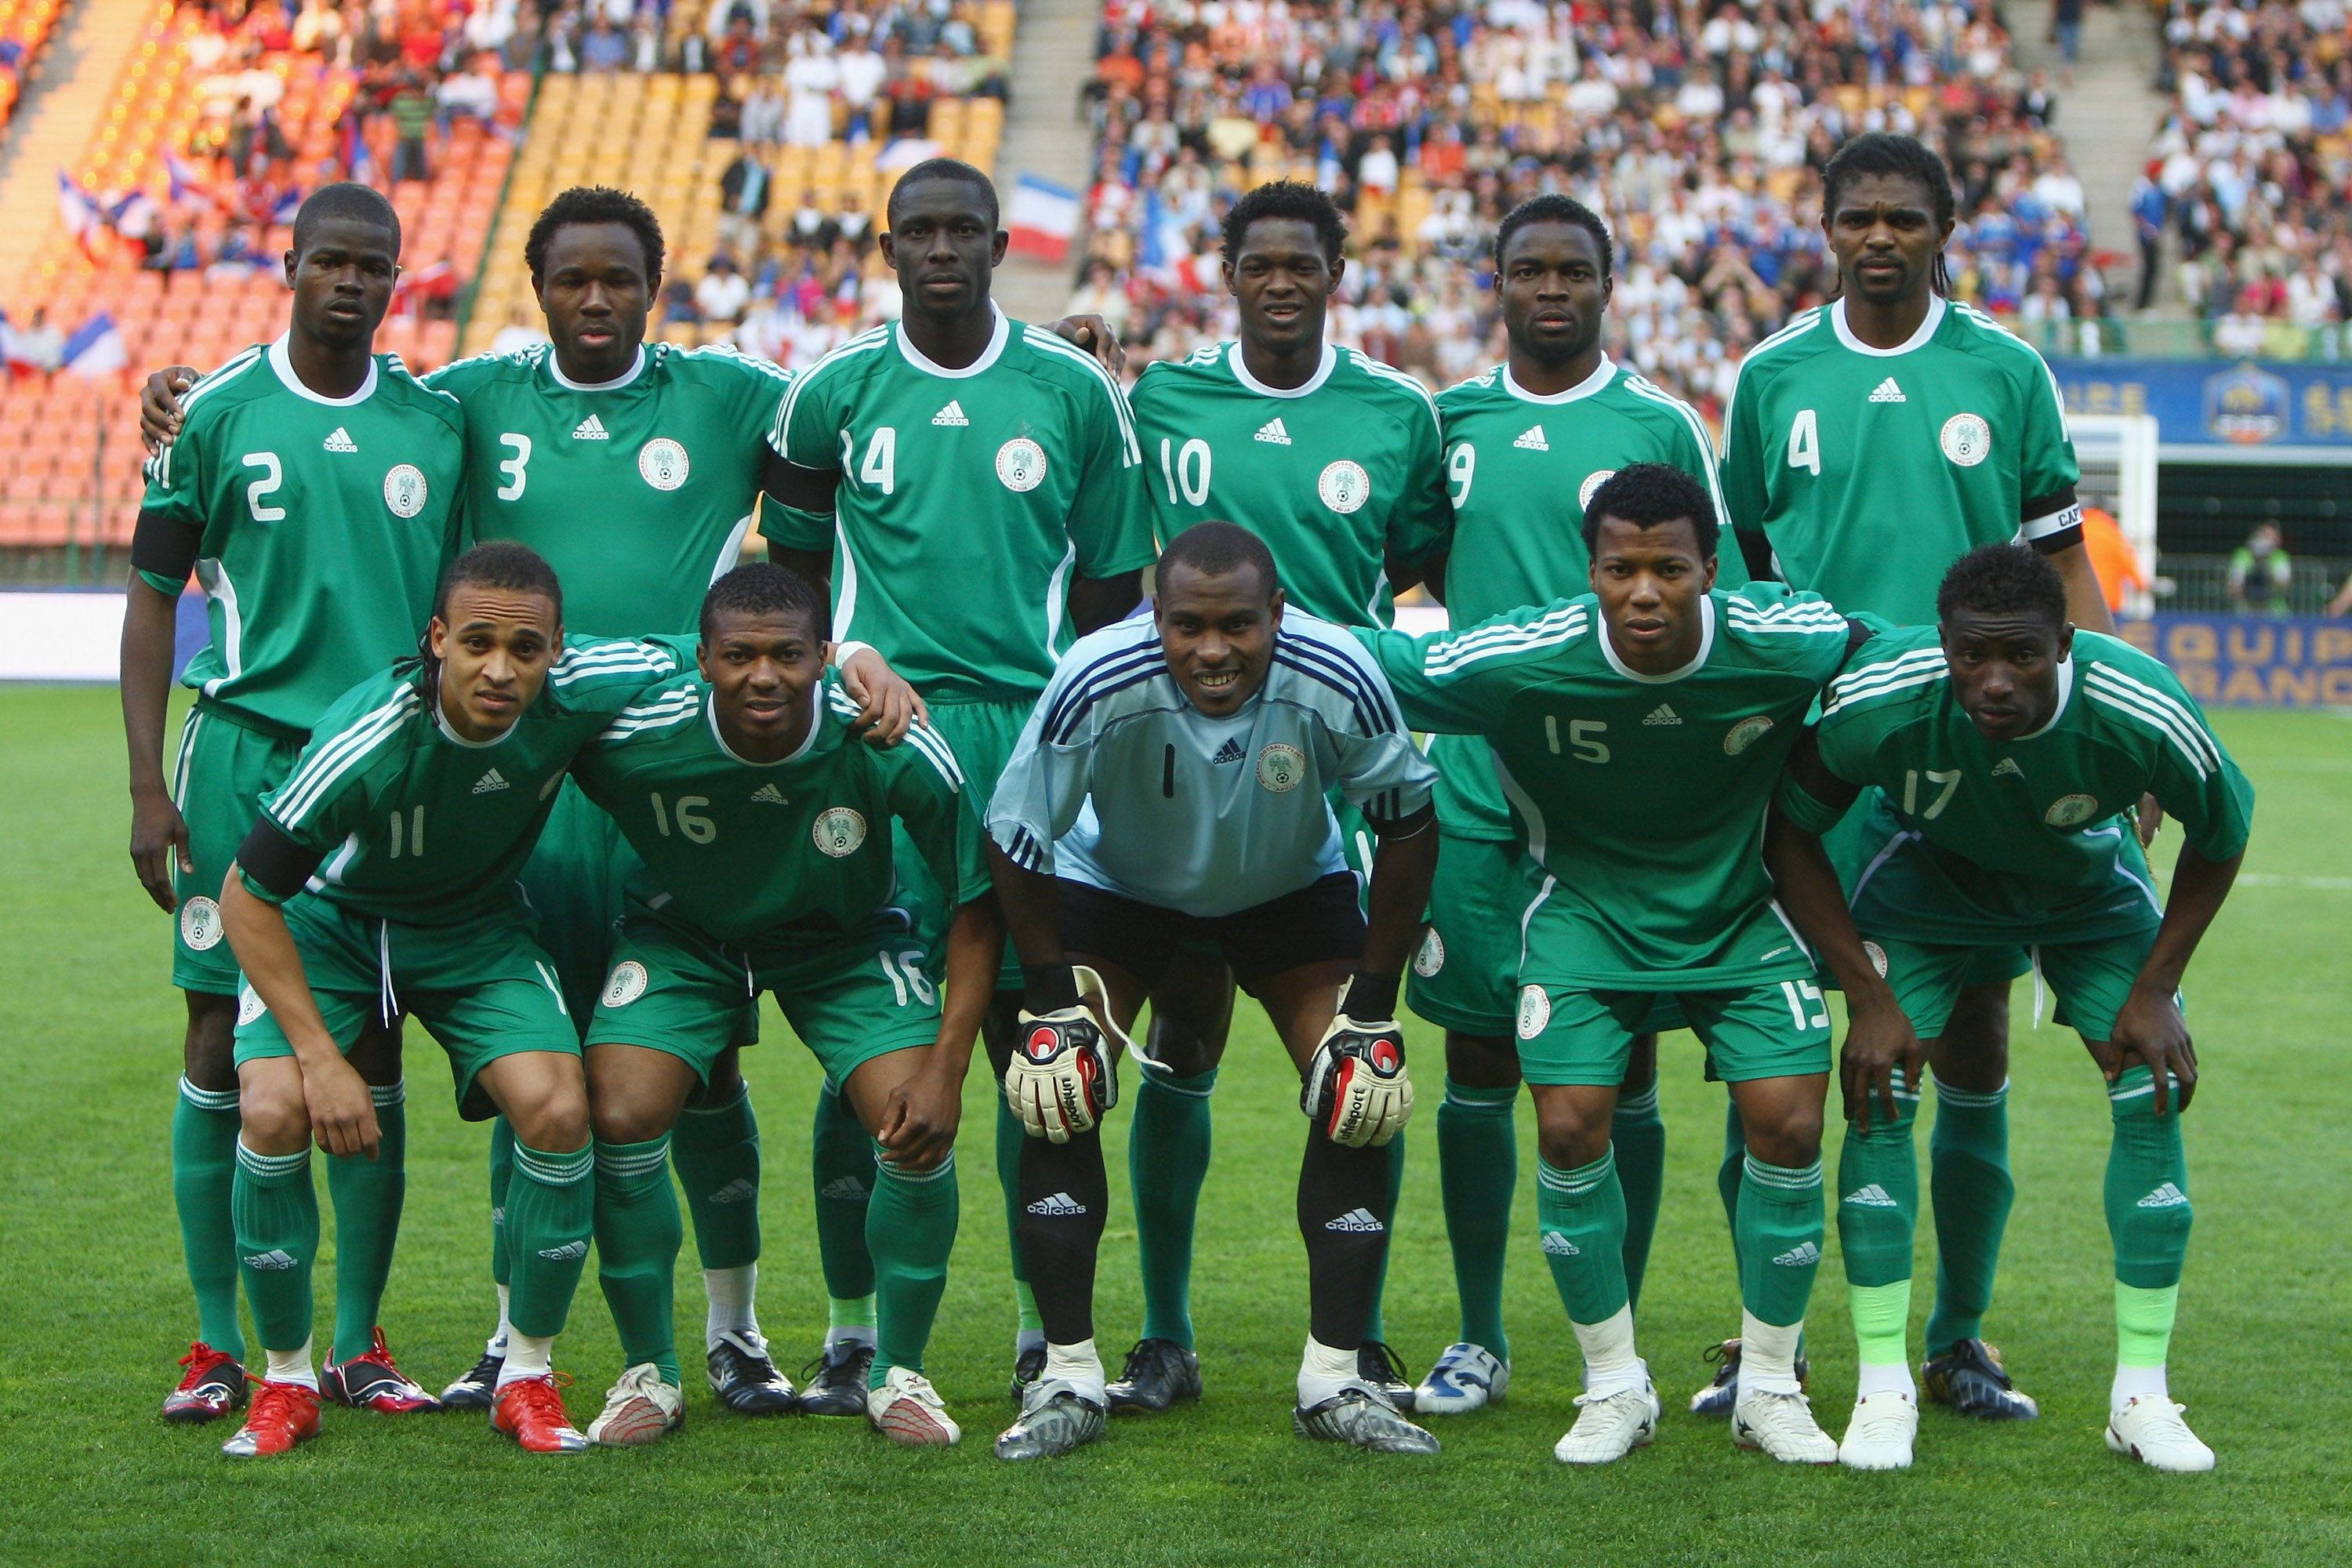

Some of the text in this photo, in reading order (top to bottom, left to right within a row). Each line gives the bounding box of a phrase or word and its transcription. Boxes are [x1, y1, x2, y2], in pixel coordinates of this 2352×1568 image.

[1868, 393, 1907, 402] adidas
[931, 416, 969, 426] adidas
[1948, 415, 1976, 426] FOOTBALL
[572, 430, 609, 440] adidas
[1254, 432, 1292, 445] adidas
[1788, 408, 1820, 476] 4
[324, 443, 358, 452] adidas
[1004, 440, 1032, 451] FOOTBALL
[1513, 439, 1549, 452] adidas
[498, 433, 532, 501] 3
[644, 440, 669, 454] FOOTBALL
[671, 442, 688, 476] FEDERATION
[840, 427, 896, 495] 14
[1327, 461, 1355, 472] FOOTBALL
[391, 466, 415, 475] FOOTBALL
[1161, 438, 1211, 506] 10
[1443, 443, 1475, 510] 9
[242, 452, 286, 521] 2
[2058, 506, 2083, 527] CAP
[1642, 717, 1682, 725] adidas
[1545, 715, 1610, 764] 15
[1213, 750, 1247, 764] adidas
[1258, 744, 1285, 760] FOOTBALL
[1163, 743, 1175, 798] 1
[472, 782, 510, 794] adidas
[1904, 769, 1962, 820] 17
[750, 794, 789, 805] adidas
[652, 792, 717, 844] 16
[818, 808, 845, 823] FOOTBALL
[848, 809, 866, 839] FEDERATION
[390, 804, 424, 858] 11
[1356, 830, 1379, 887] 1
[879, 950, 935, 1007] 16
[1780, 979, 1830, 1031] 15
[1062, 1077, 1086, 1128] uhlsport
[1341, 1087, 1367, 1140] uhlsport
[1027, 1204, 1087, 1215] adidas
[1845, 1196, 1897, 1207] adidas
[2137, 1195, 2187, 1207] adidas
[1325, 1221, 1384, 1232] adidas
